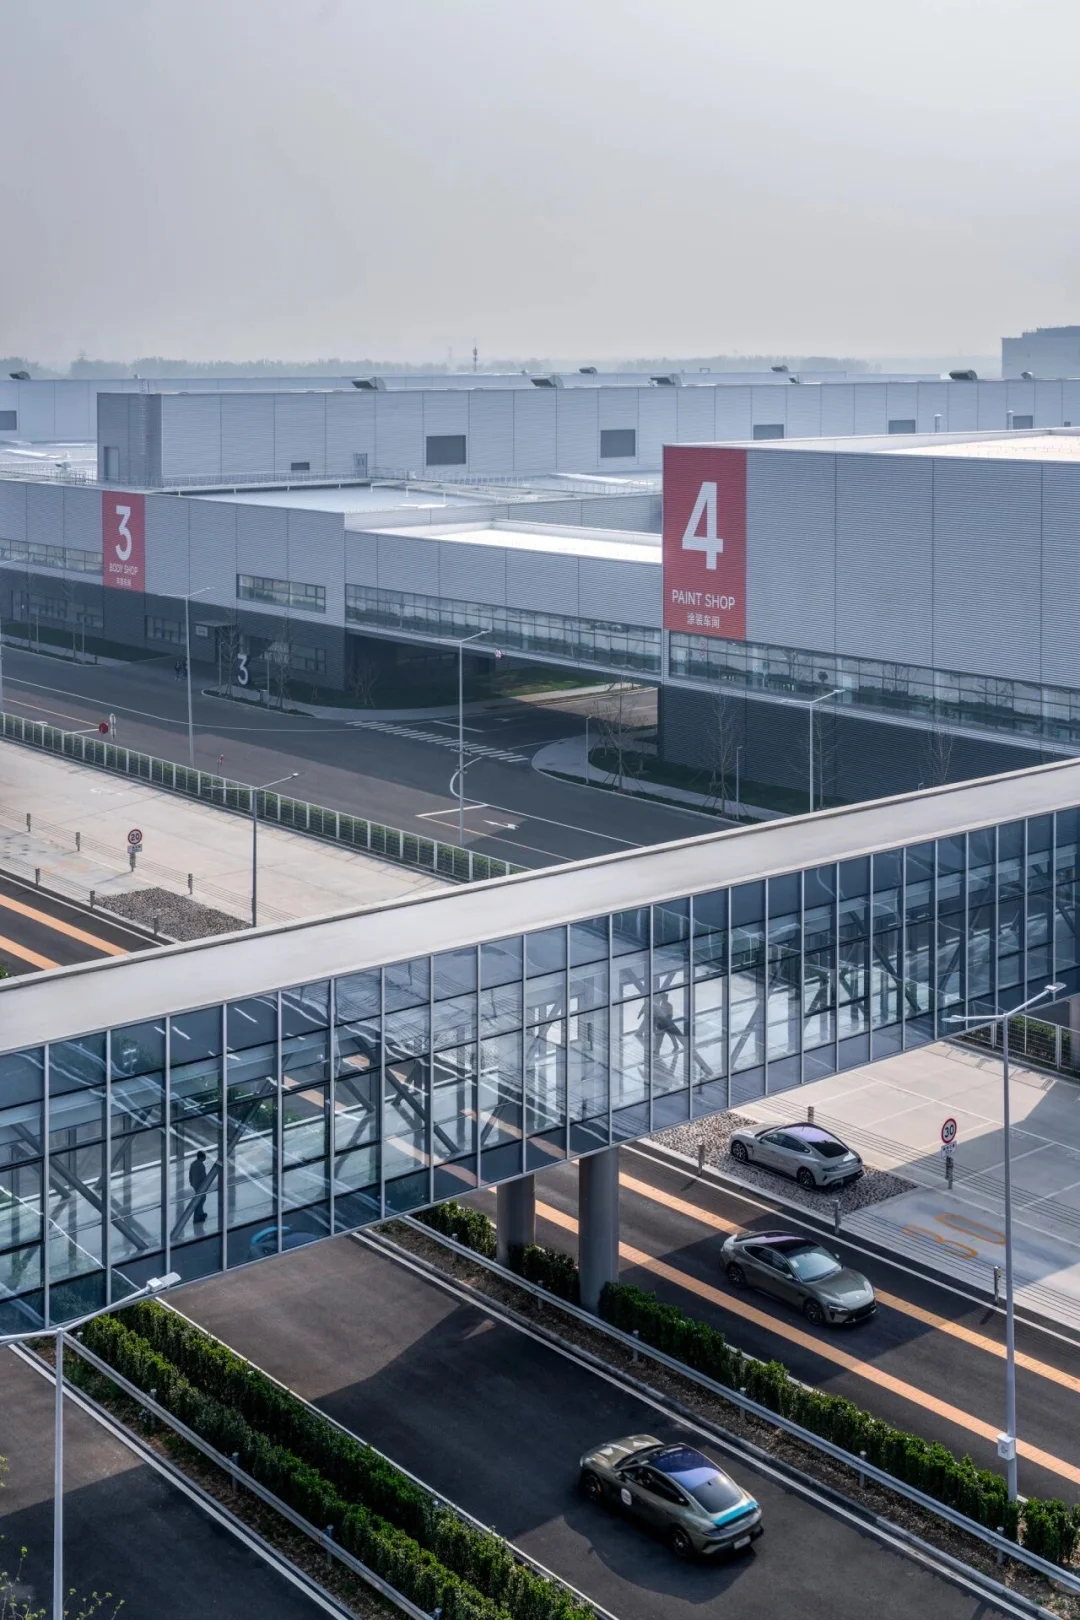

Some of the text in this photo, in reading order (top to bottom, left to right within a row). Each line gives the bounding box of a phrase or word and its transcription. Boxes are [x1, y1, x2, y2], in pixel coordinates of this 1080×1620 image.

[115, 505, 132, 561] 3
[682, 481, 723, 570] 4
[109, 562, 138, 575] BODY SHOP
[672, 589, 736, 610] PAINT SHOP
[687, 612, 720, 629] 涂装车间
[237, 653, 249, 685] 3
[130, 833, 140, 841] 20
[944, 1124, 954, 1138] 30
